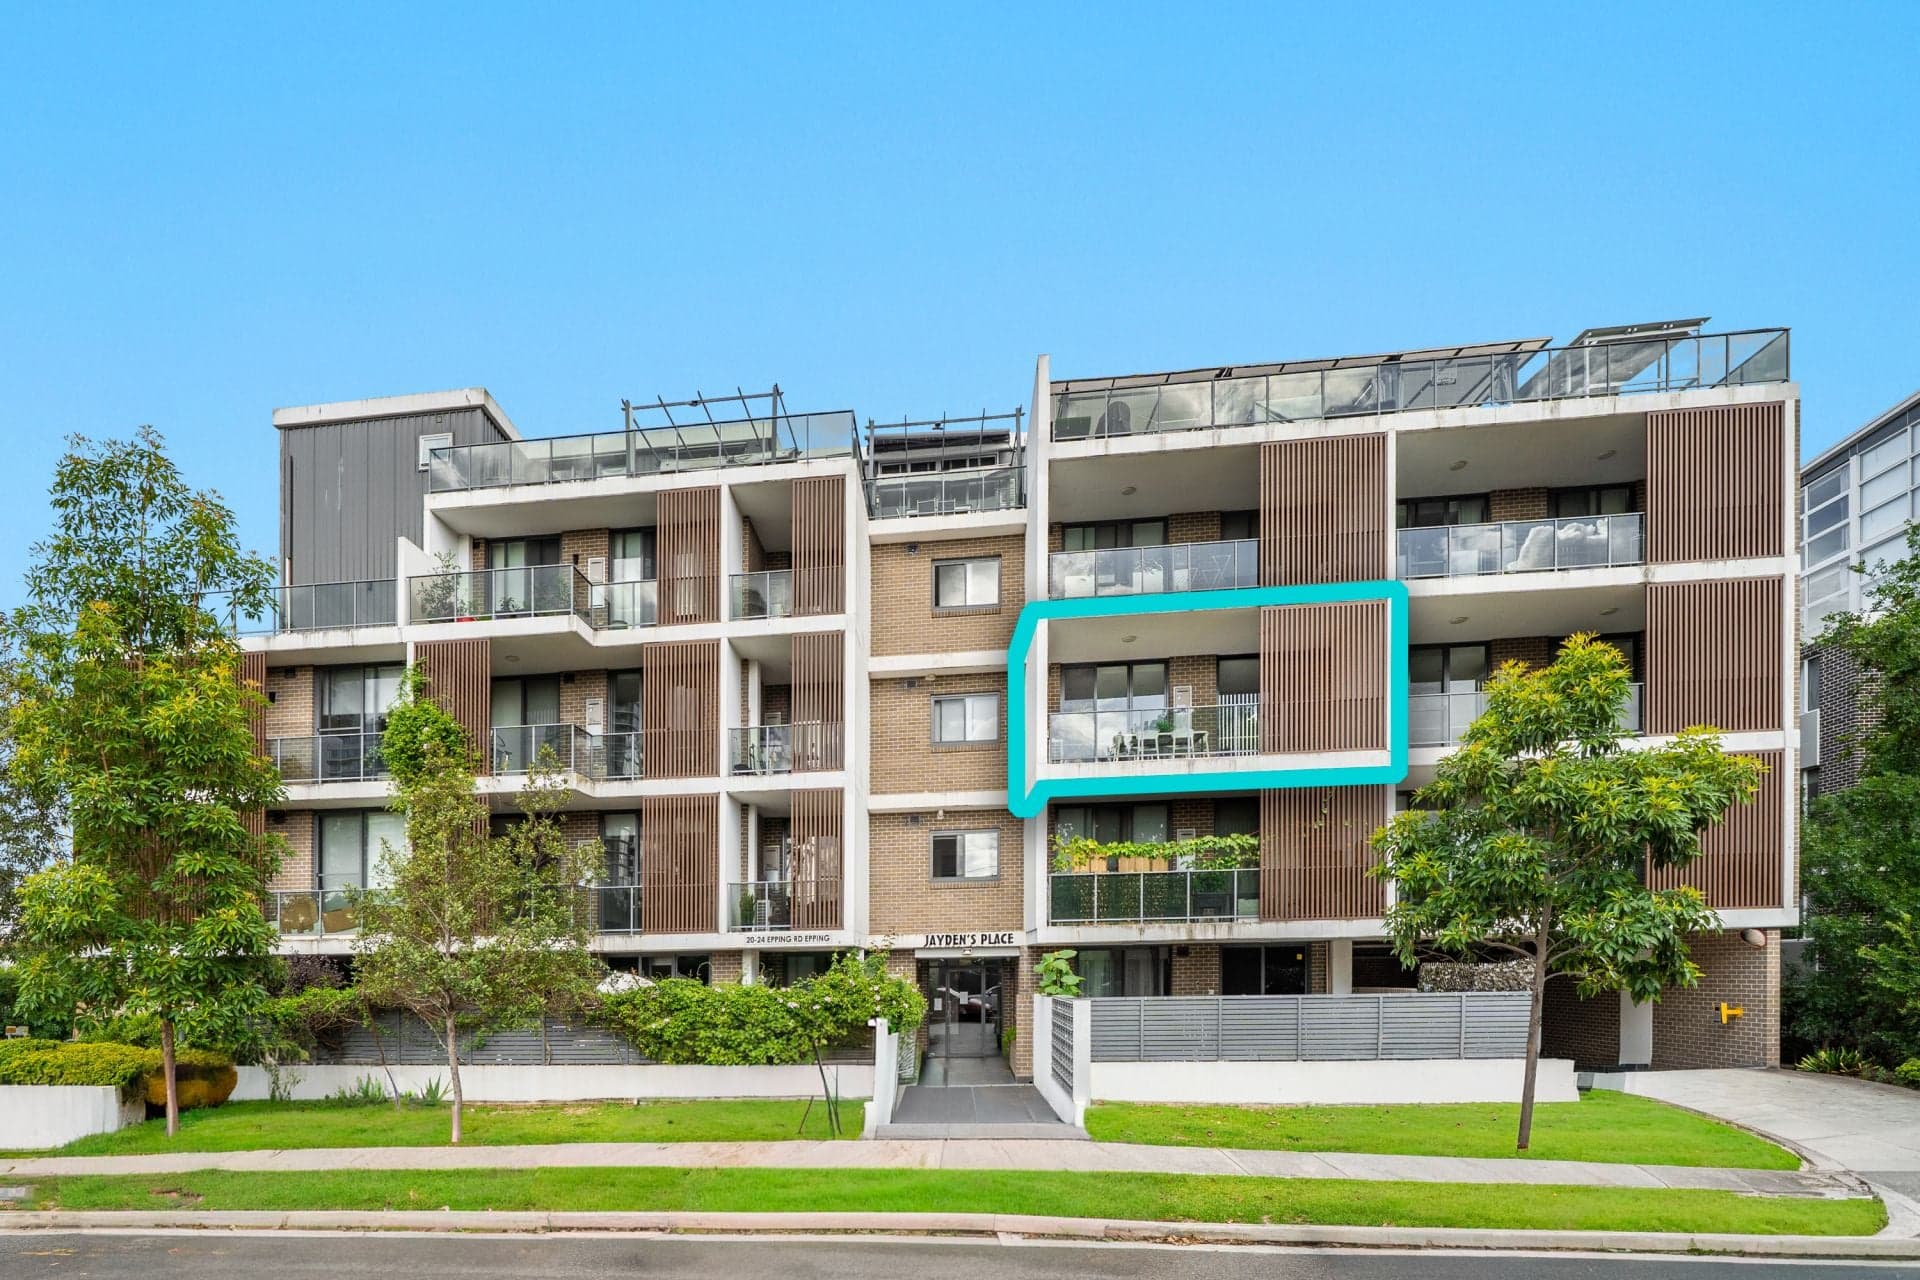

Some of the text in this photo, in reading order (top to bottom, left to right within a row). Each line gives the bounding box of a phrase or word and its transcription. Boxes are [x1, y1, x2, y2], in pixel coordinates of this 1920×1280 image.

[805, 934, 830, 942] EPPING
[924, 933, 1014, 947] JAYDEN'S PLACE
